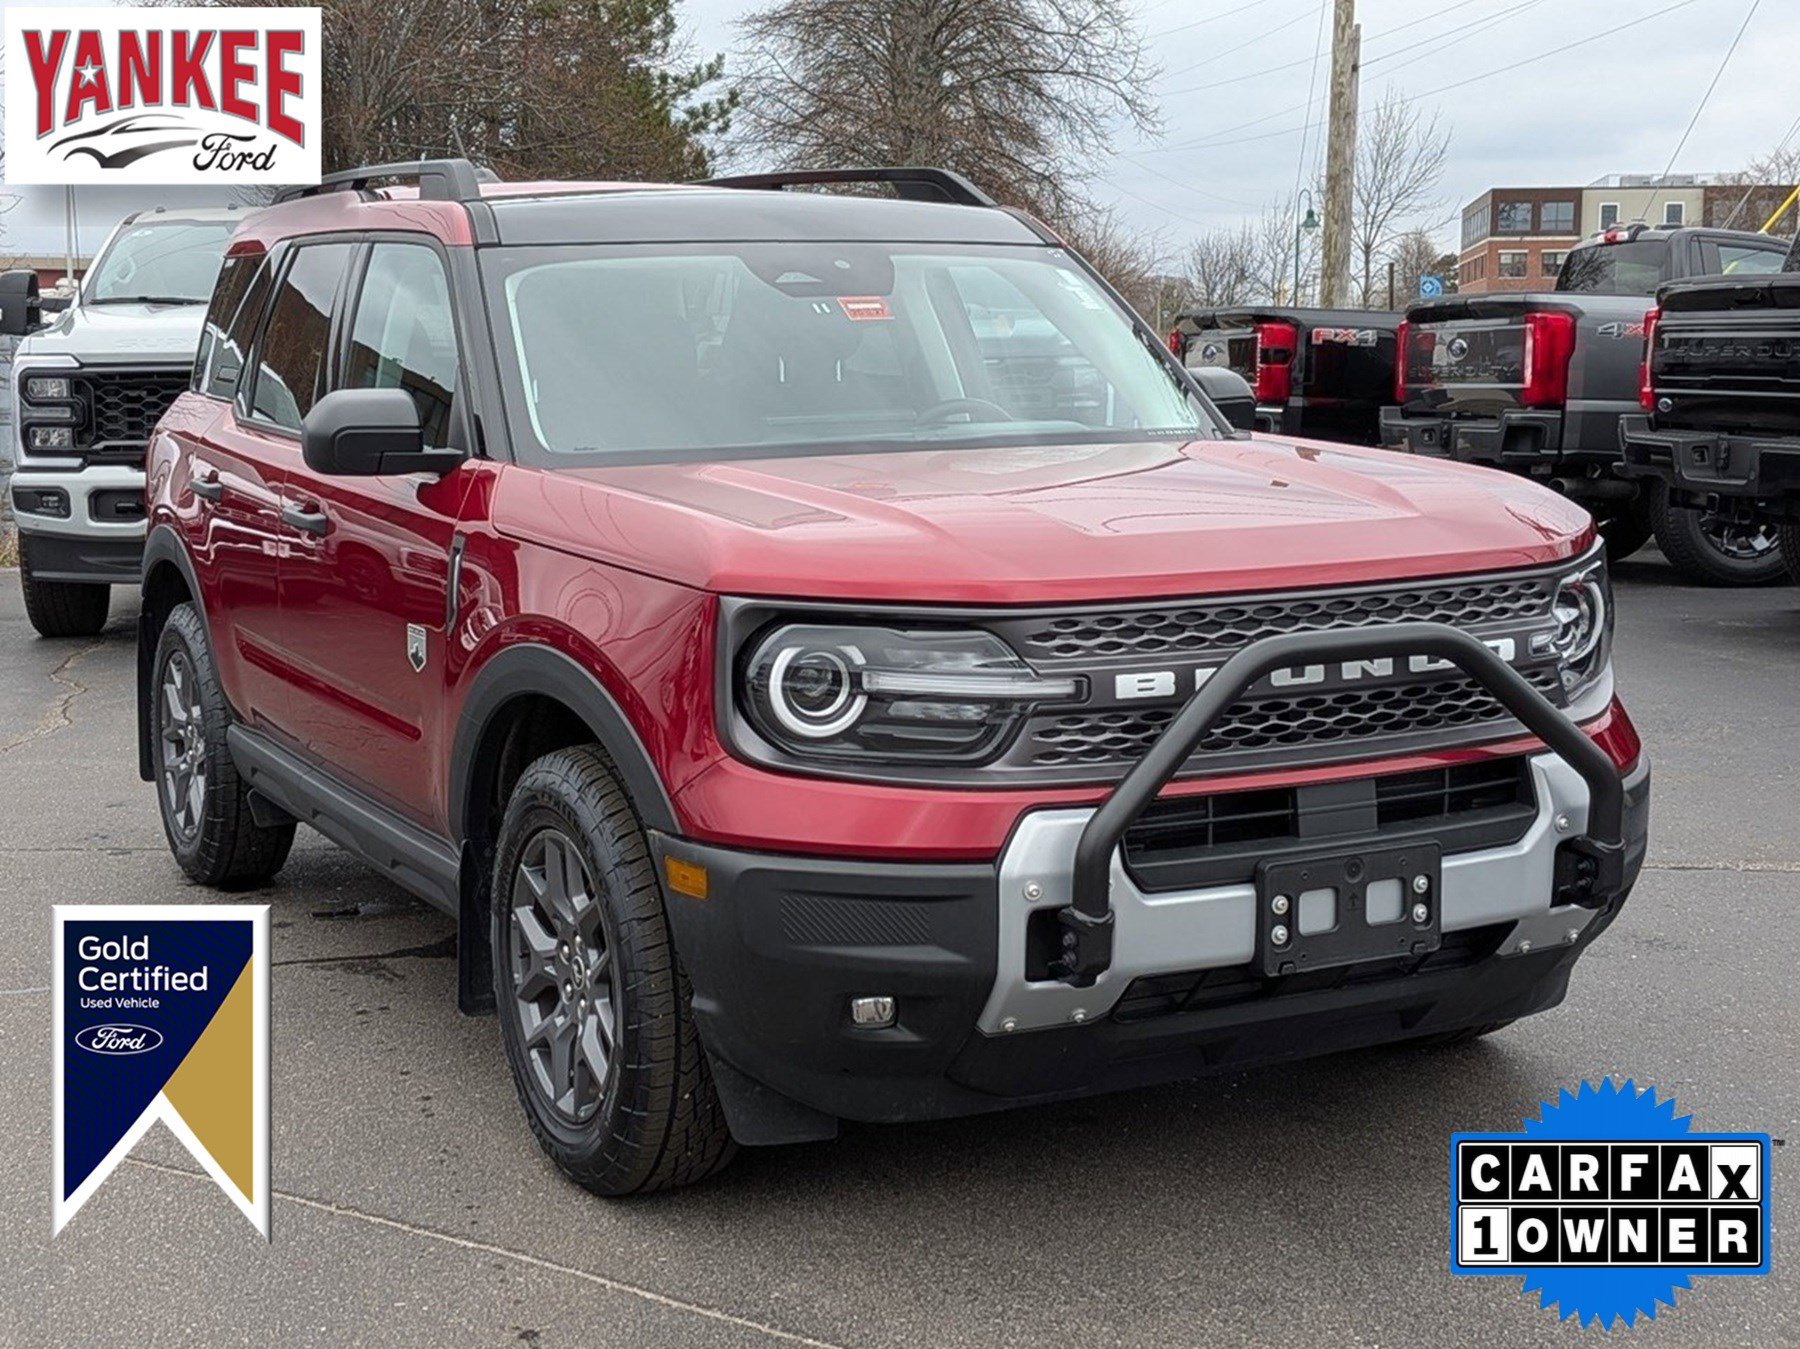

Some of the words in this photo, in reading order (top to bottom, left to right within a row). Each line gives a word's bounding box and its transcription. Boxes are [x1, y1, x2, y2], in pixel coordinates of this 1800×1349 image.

[1312, 327, 1378, 347] FX4
[1598, 322, 1646, 339] 4X
[1115, 638, 1515, 699] BONC
